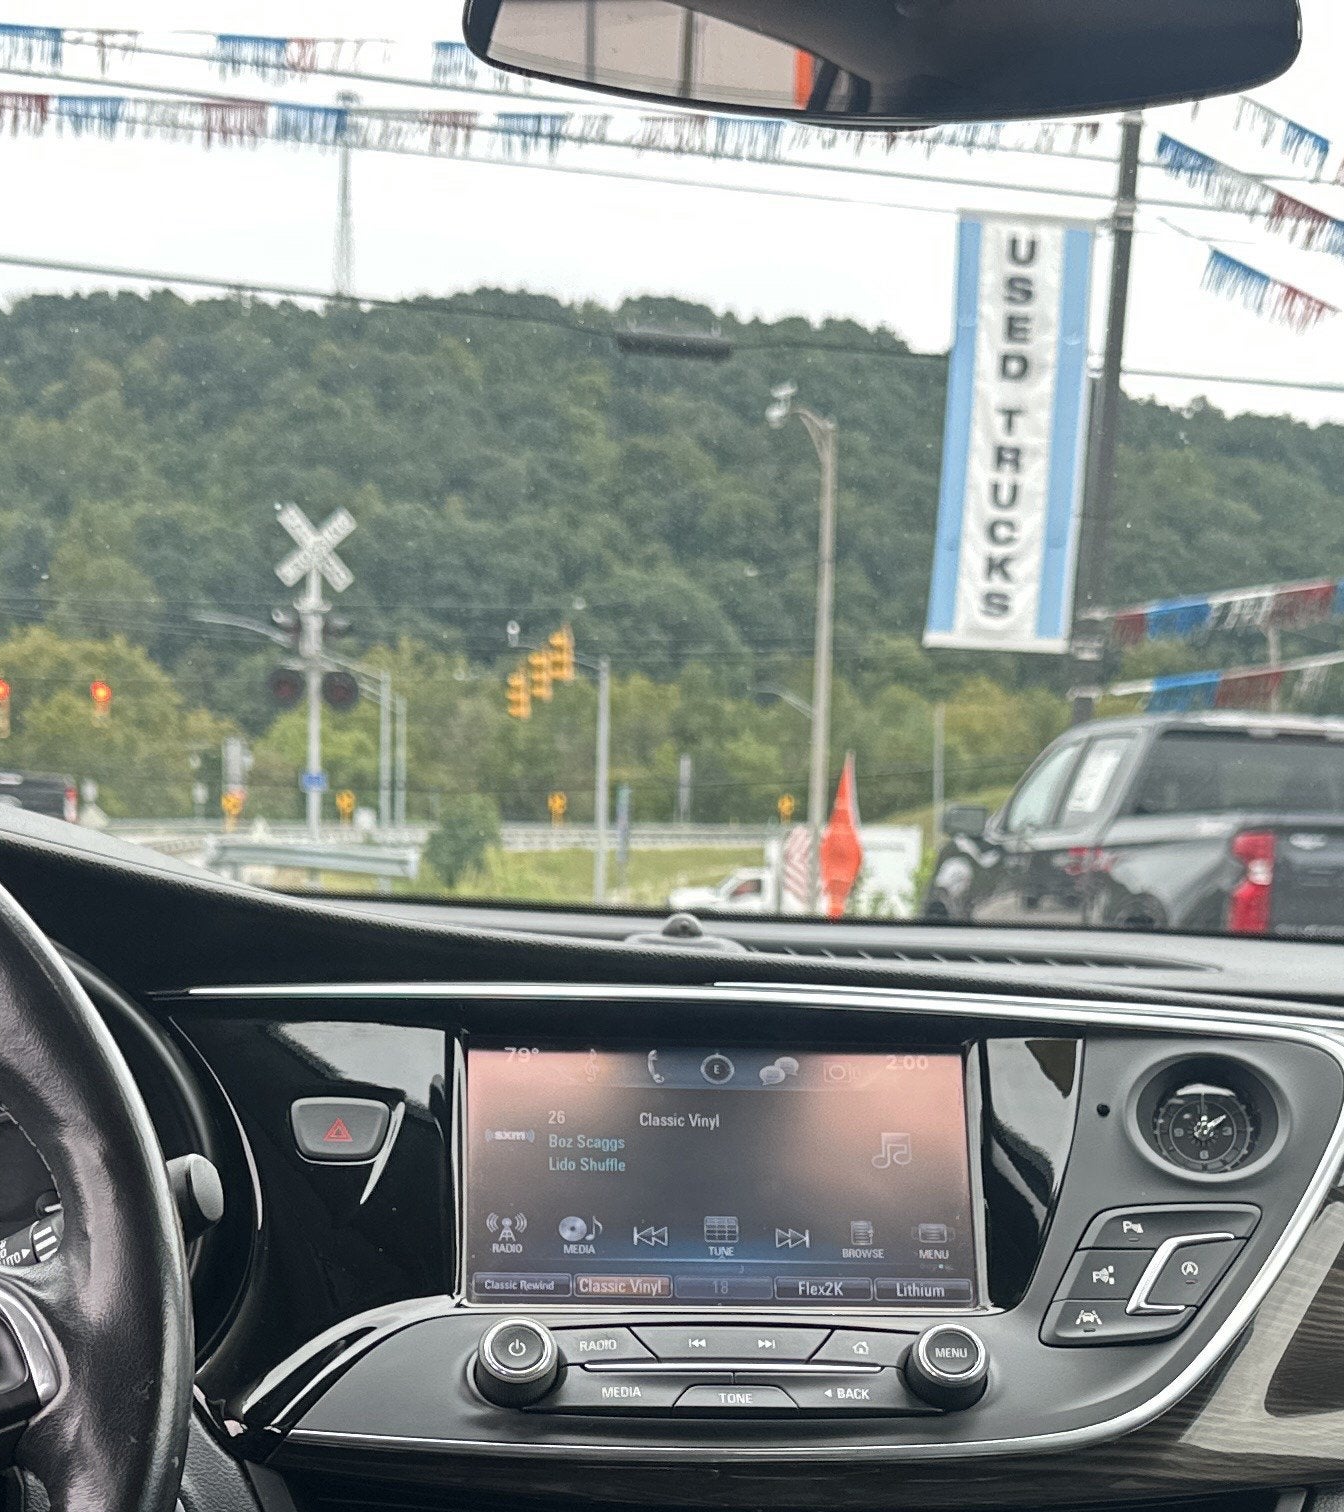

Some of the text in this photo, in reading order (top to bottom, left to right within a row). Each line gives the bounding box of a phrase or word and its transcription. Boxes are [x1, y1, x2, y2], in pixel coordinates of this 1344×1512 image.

[981, 237, 1038, 619] USED TRUCKS
[548, 1110, 566, 1125] 26
[639, 1111, 720, 1131] Classic Vinyl
[548, 1134, 626, 1152] Boz Scaggs
[548, 1156, 626, 1172] Lido Shuffle
[491, 1243, 523, 1254] RADIO
[563, 1244, 596, 1255] MEDIA
[709, 1246, 734, 1256] TUNE
[842, 1248, 885, 1259] BROWSE
[918, 1249, 950, 1260] MENU
[484, 1279, 555, 1291] Classic Rewind
[578, 1277, 662, 1297] Classic Vinyl
[711, 1279, 729, 1294] 18
[798, 1280, 844, 1297] Flex2K
[896, 1281, 945, 1298] Lithium
[579, 1338, 618, 1353] RADIO
[934, 1346, 968, 1360] MENU
[601, 1385, 642, 1399] MEDIA
[718, 1391, 753, 1405] TONE
[837, 1386, 871, 1401] BACK
